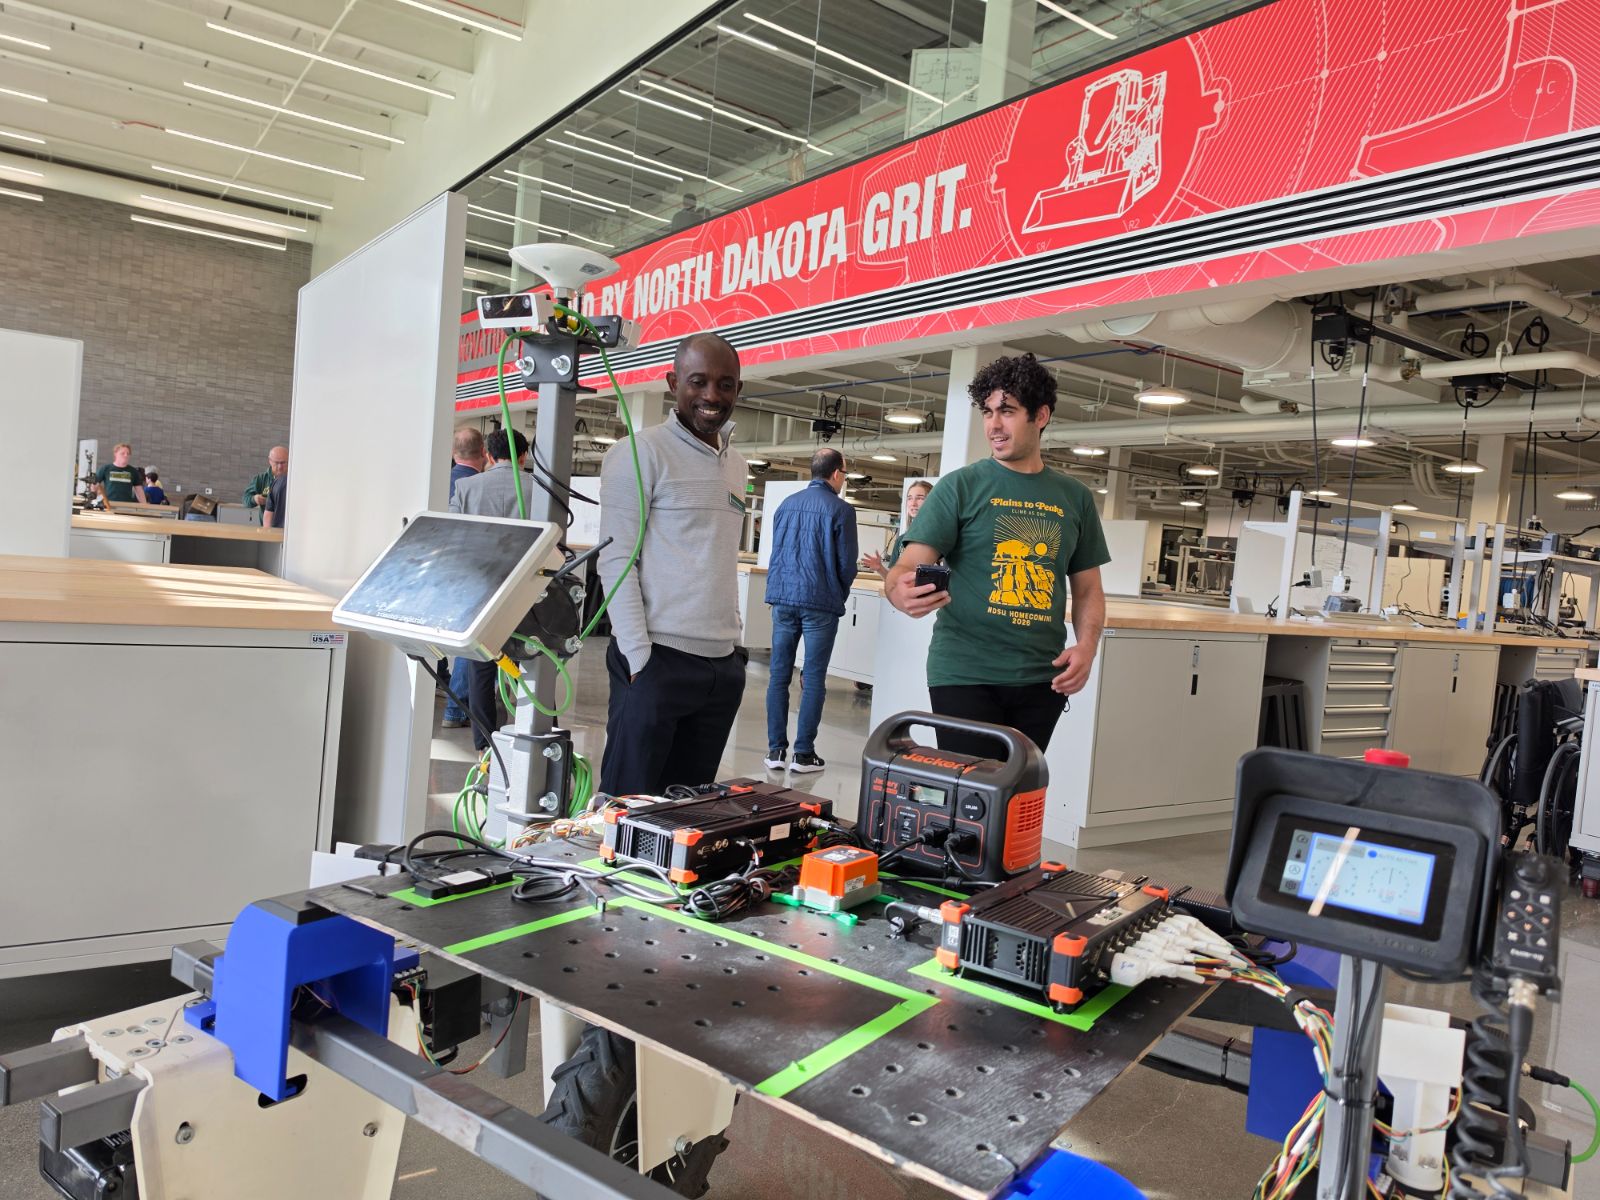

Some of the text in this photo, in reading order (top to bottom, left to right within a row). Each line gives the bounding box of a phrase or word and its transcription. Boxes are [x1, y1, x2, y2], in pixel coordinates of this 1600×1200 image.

[634, 254, 713, 320] NORTH
[720, 206, 848, 288] DAKOTA
[862, 164, 973, 256] GRIT.
[989, 497, 1065, 518] Plains to Peaks
[987, 606, 1007, 617] NDSU
[902, 753, 977, 776] Jackery
